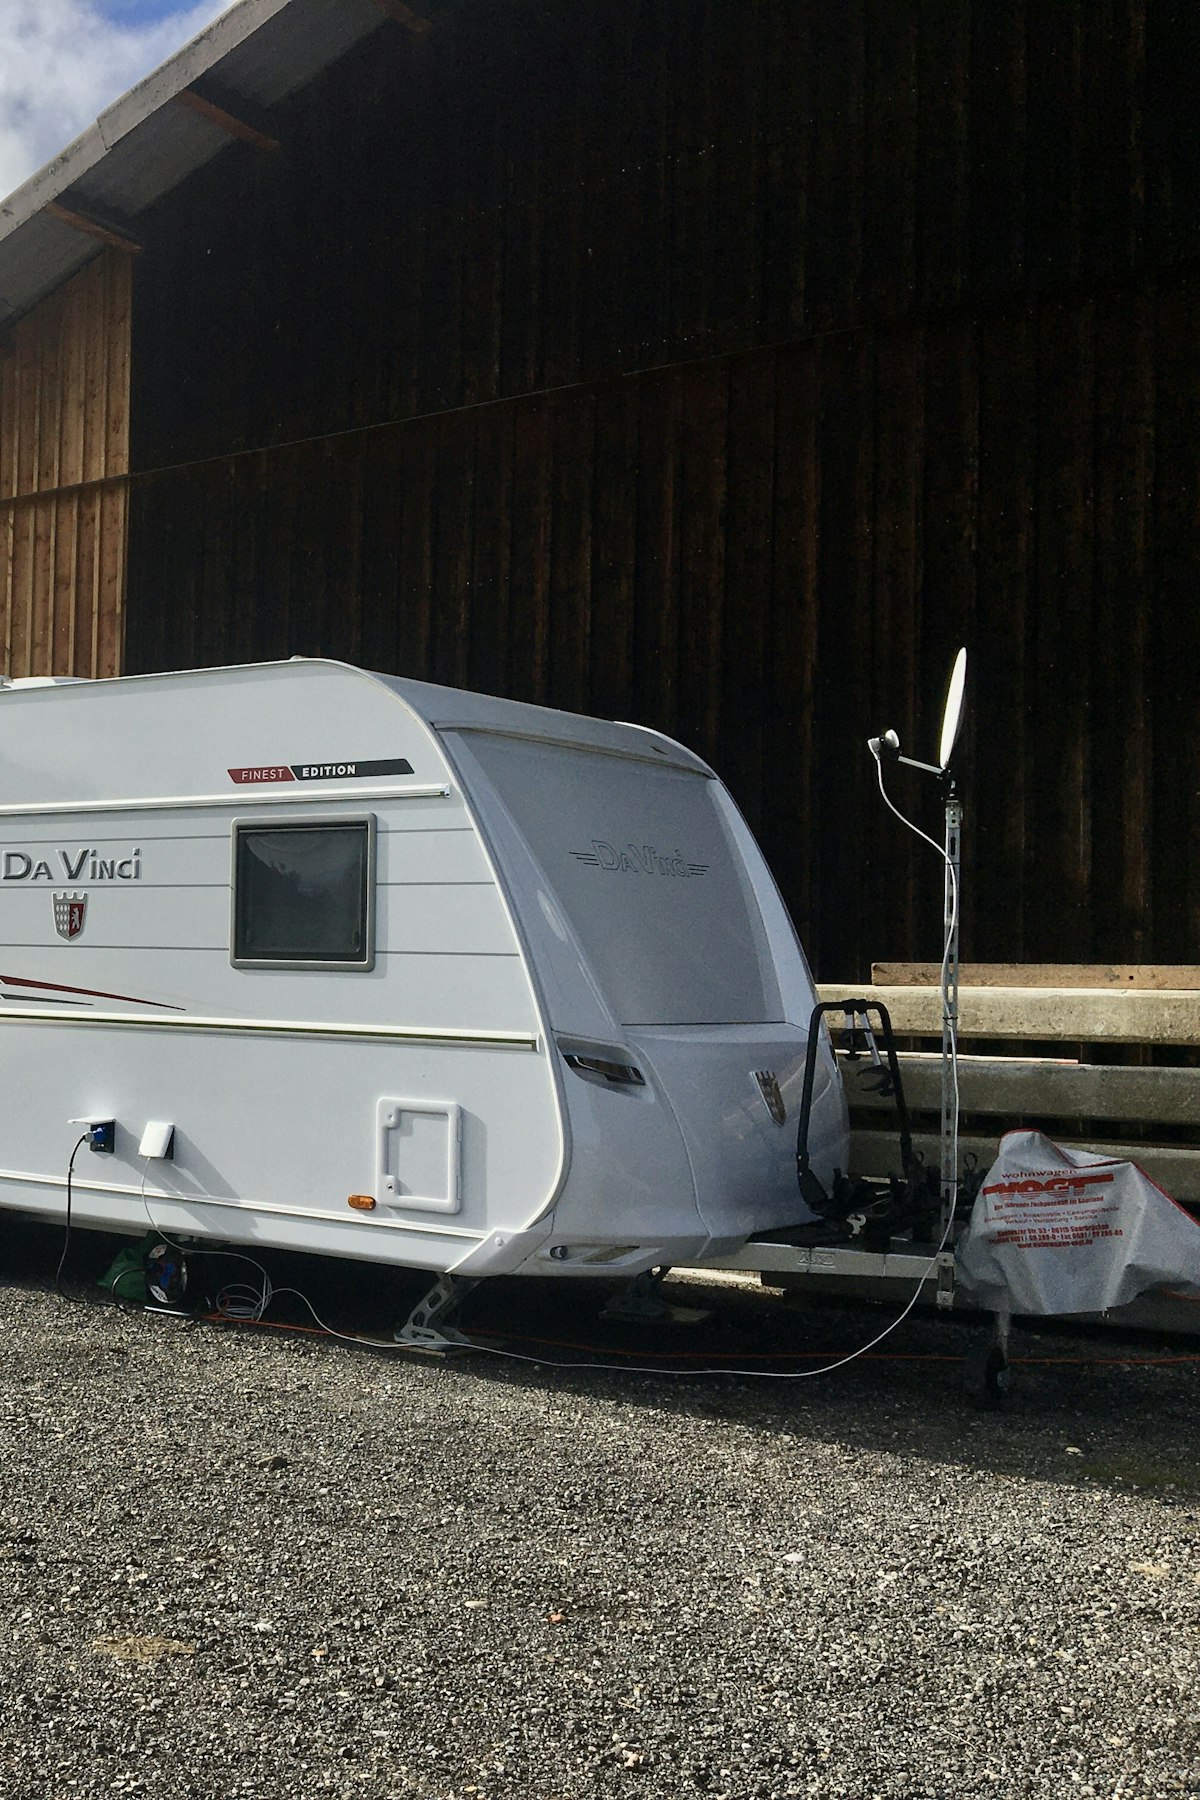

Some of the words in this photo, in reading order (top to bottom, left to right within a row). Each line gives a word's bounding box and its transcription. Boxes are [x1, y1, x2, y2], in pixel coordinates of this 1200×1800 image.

[241, 769, 285, 781] FINEST
[302, 765, 356, 778] EDITION
[983, 1173, 1114, 1200] VOGT
